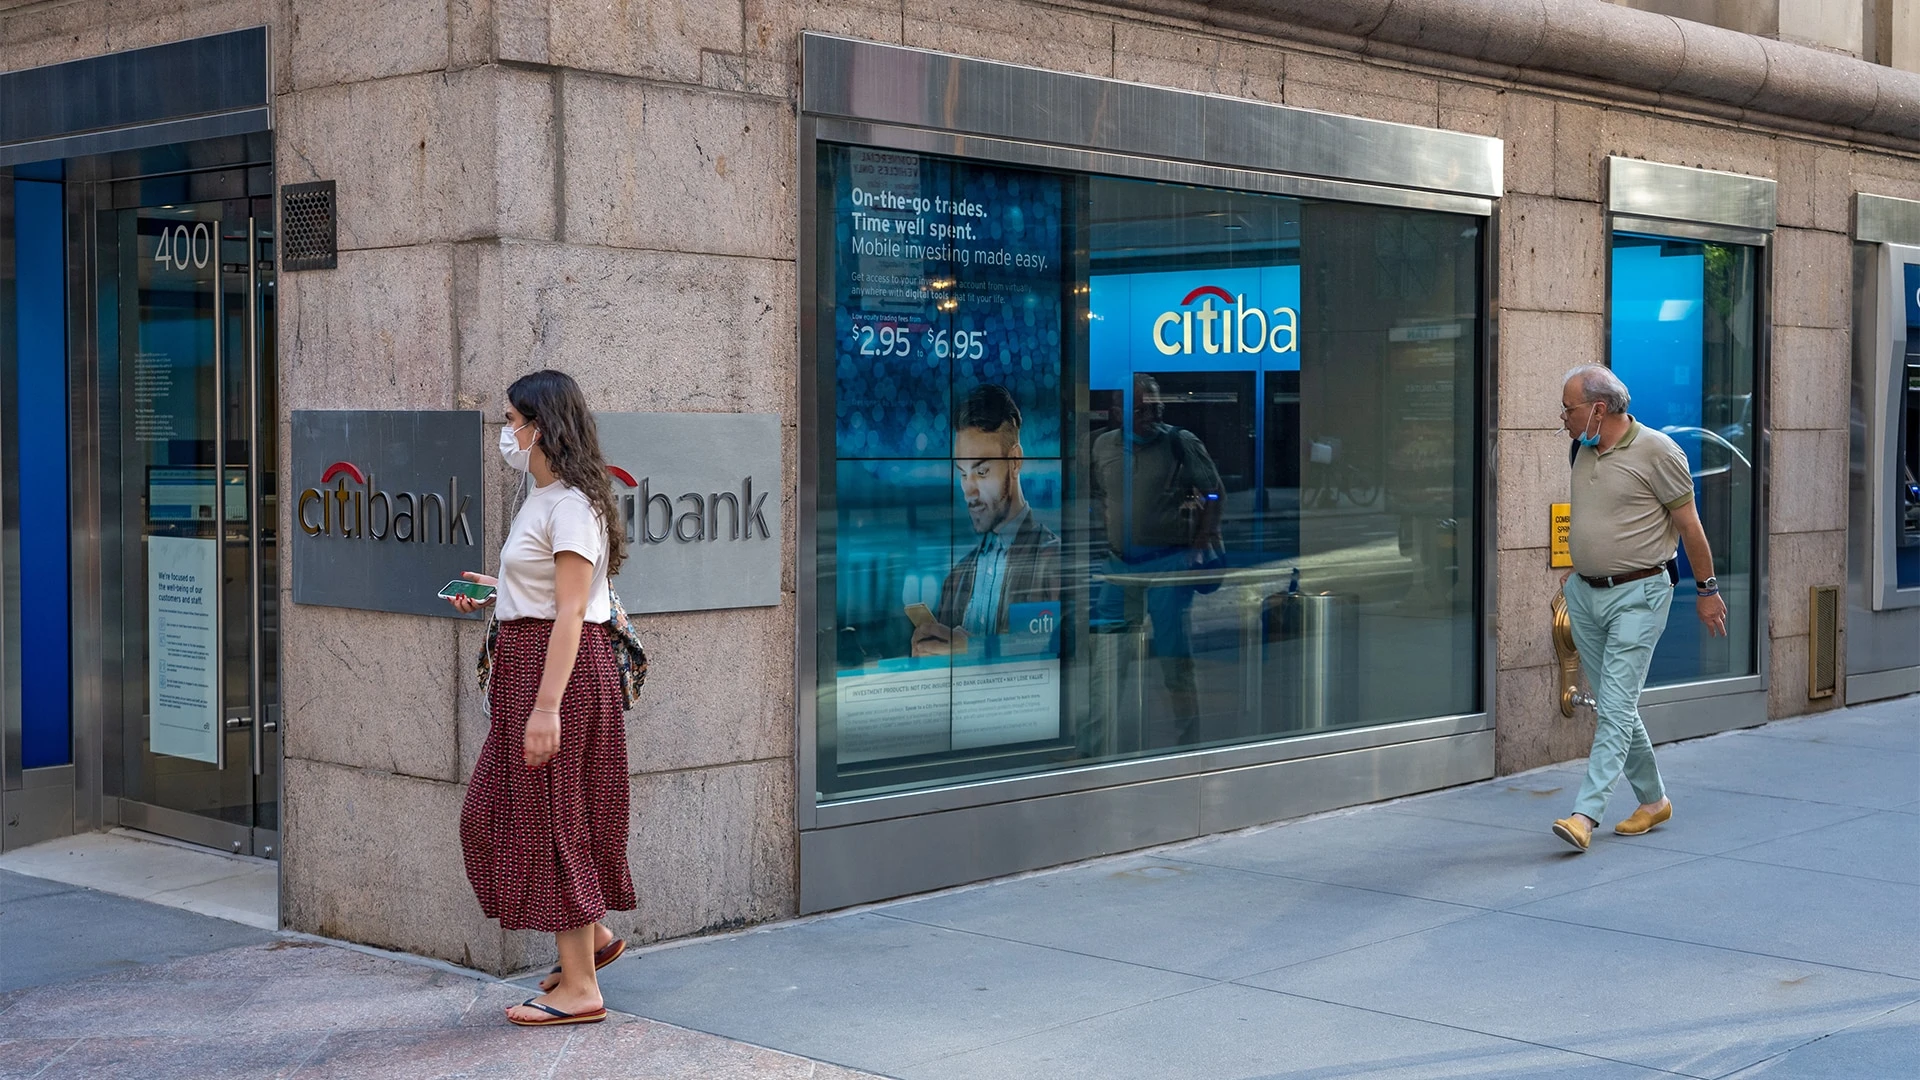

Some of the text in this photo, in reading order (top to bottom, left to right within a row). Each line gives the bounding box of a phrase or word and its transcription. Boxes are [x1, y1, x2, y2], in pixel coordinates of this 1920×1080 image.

[851, 187, 987, 218] On-the-go trades.
[851, 212, 976, 241] Time well spent.
[154, 223, 210, 270] 400
[852, 236, 1048, 272] Mobile investing made easy.
[851, 271, 864, 282] Get
[866, 274, 890, 284] access
[891, 275, 899, 284] to
[900, 277, 917, 286] your
[959, 280, 986, 289] account
[988, 281, 1004, 291] from
[851, 286, 887, 297] anywhere
[888, 290, 904, 298] with
[905, 289, 929, 300] digital
[931, 290, 949, 300] tools
[953, 293, 966, 301] hat
[967, 294, 975, 302] fit
[976, 295, 992, 304] your
[852, 312, 862, 320] Low
[1153, 293, 1297, 356] citiba
[852, 324, 911, 357] $2.95
[916, 349, 924, 357] to
[298, 474, 474, 546] citibank
[614, 475, 770, 544] ibank
[158, 572, 170, 580] We're
[171, 573, 188, 582] focused
[158, 583, 203, 594] the well-being of our
[158, 594, 203, 605] customers and staff.
[1029, 614, 1053, 634] citi
[852, 687, 883, 697] INVESTMENT
[976, 677, 1003, 685] GUARANTEE
